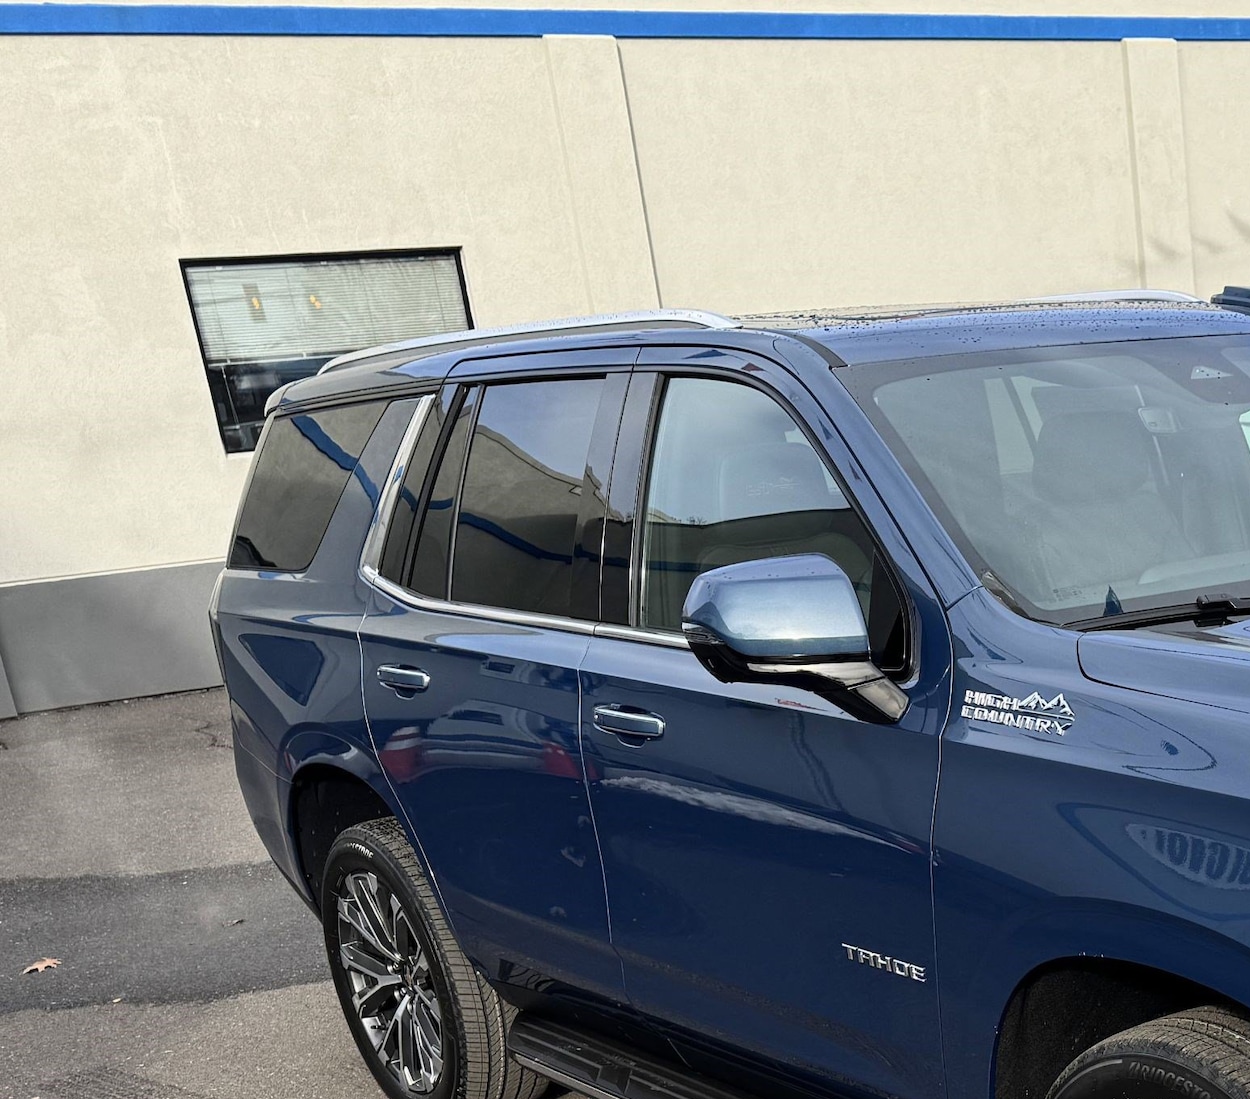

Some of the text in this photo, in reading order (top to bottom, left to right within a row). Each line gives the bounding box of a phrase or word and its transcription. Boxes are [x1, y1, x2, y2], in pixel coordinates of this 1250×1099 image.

[964, 689, 1021, 711] HIGH
[960, 704, 1073, 737] COUNTRY
[841, 943, 927, 983] TAHOE
